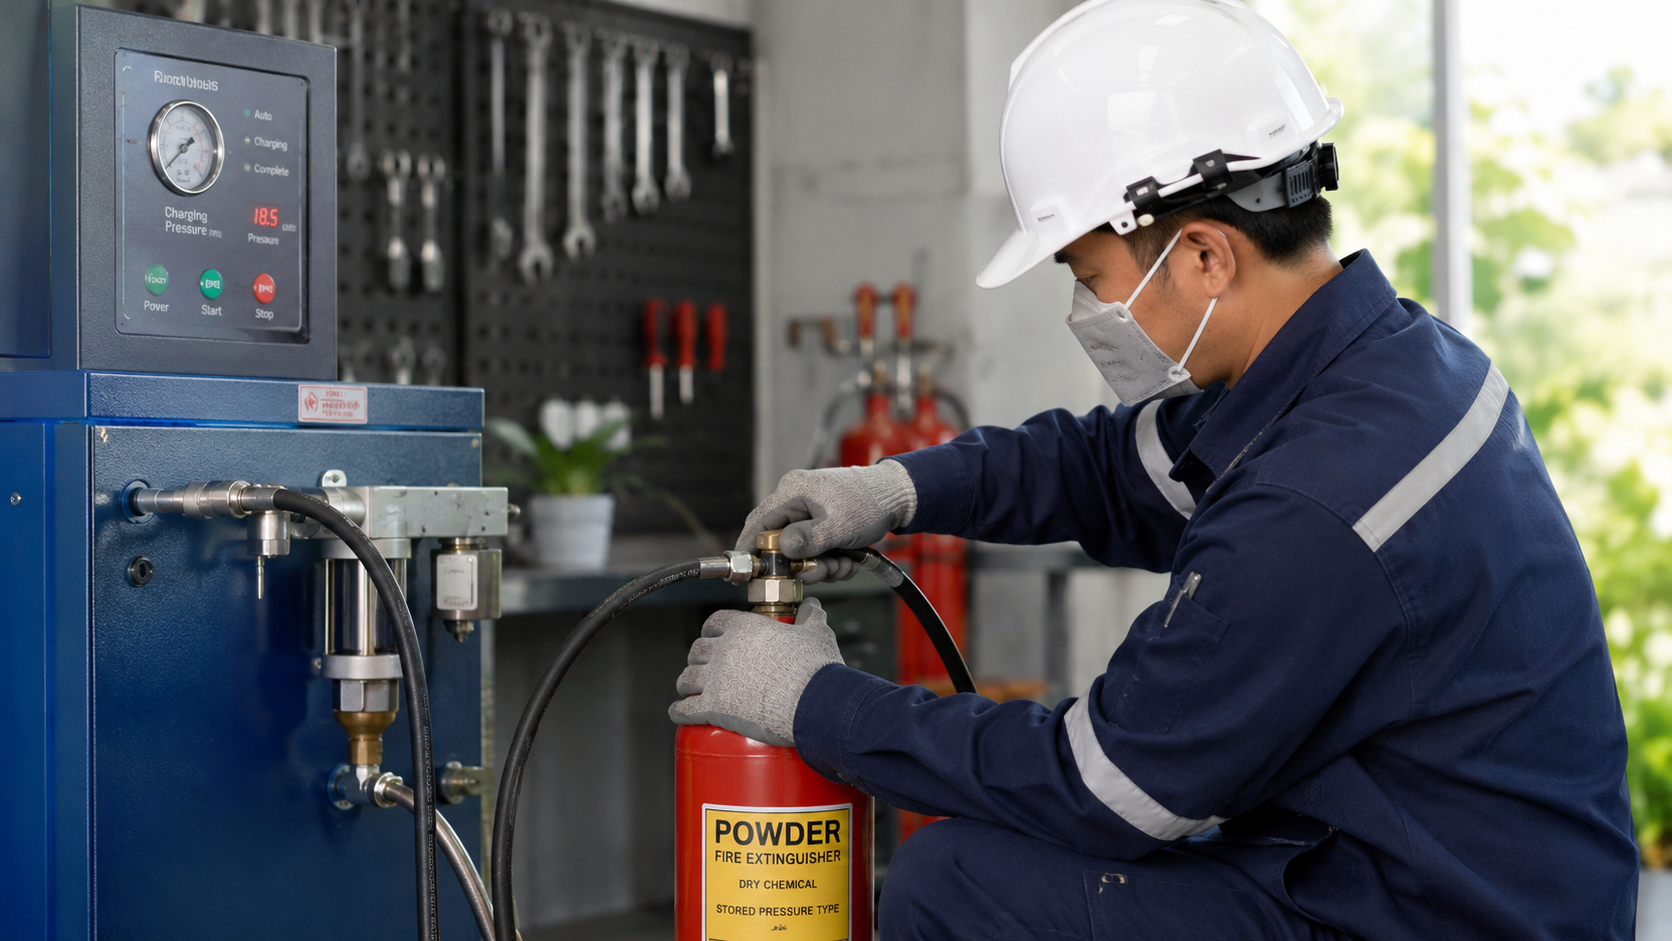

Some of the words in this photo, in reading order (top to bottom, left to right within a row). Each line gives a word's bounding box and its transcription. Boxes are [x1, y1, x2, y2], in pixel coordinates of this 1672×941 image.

[254, 110, 273, 122] Auto
[254, 136, 288, 151] Charging
[254, 163, 290, 177] Complete
[165, 206, 208, 224] Charging
[254, 207, 279, 227] 18.5
[165, 221, 208, 236] Pressure
[201, 304, 223, 317] Start
[255, 308, 275, 322] Stop
[715, 819, 841, 847] POWDER
[715, 850, 742, 864] FIRE
[746, 850, 841, 865] EXTINGUISHER
[739, 879, 761, 890] DRY
[763, 879, 818, 890] CHEMICAL
[716, 904, 756, 917] STORED
[759, 906, 813, 917] PRESSURE
[816, 903, 840, 915] TYPE
